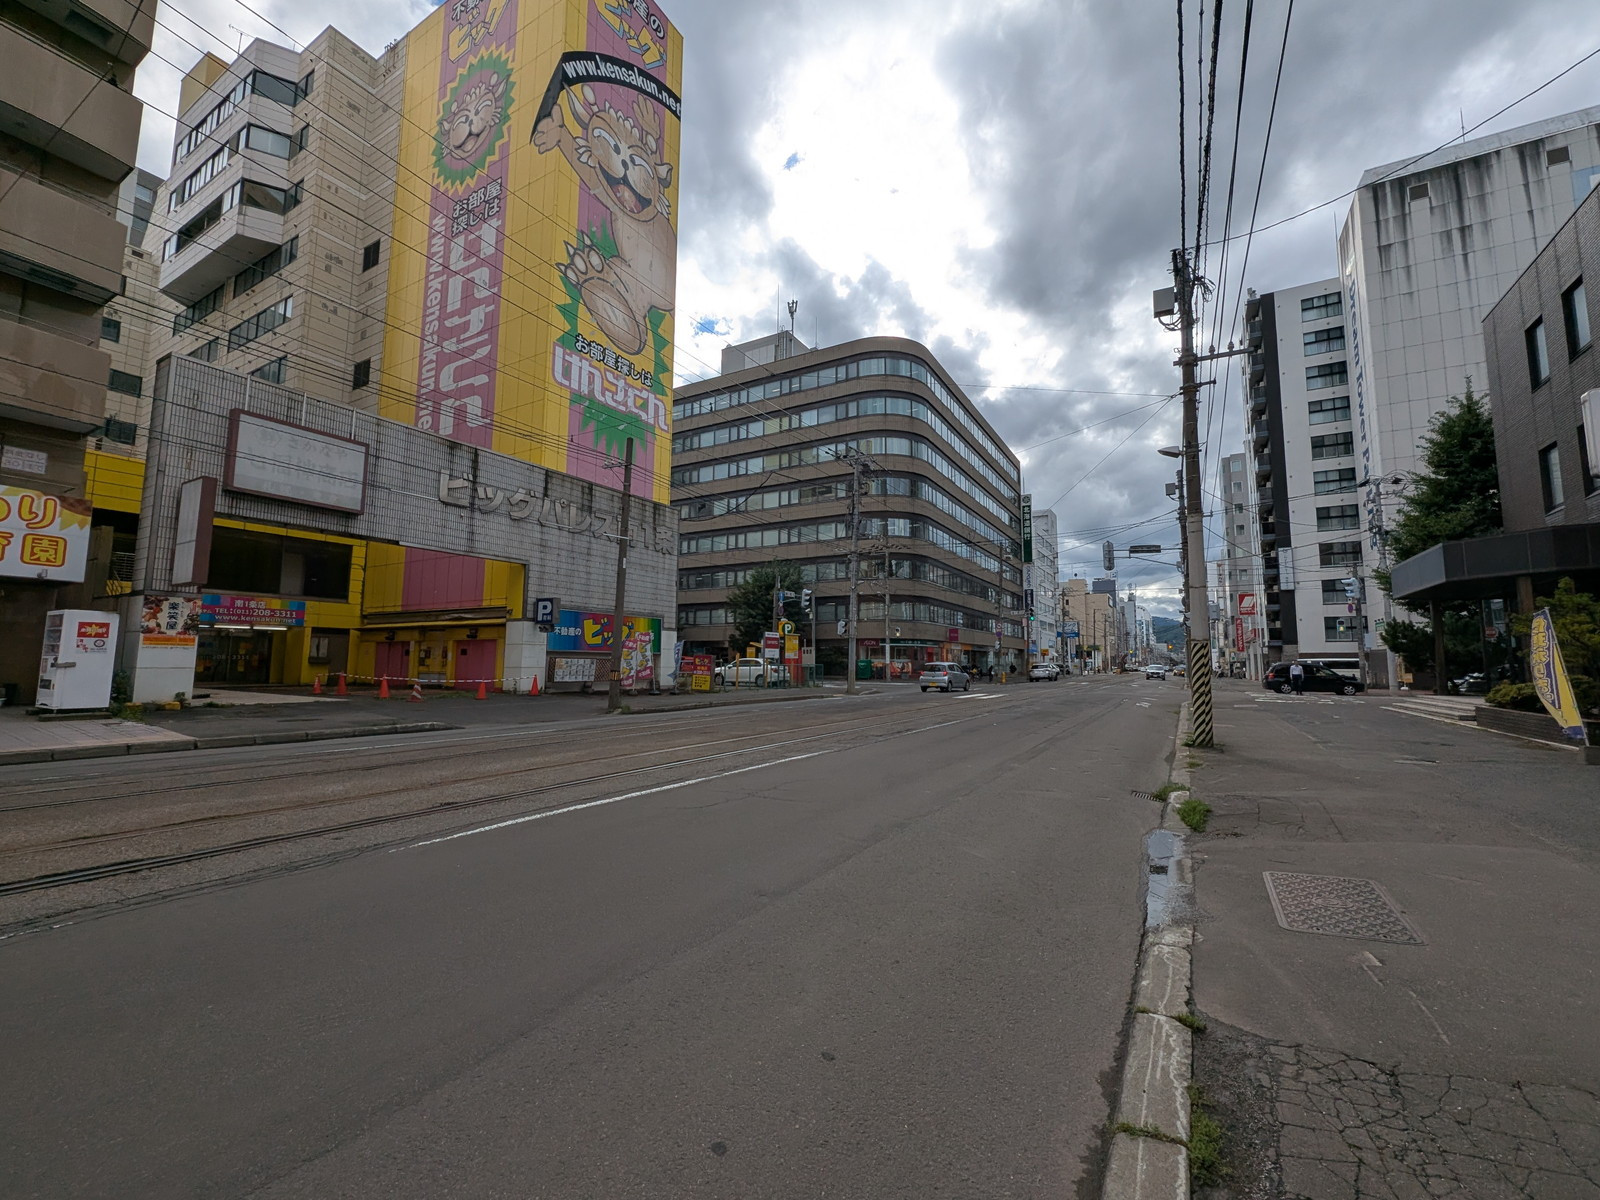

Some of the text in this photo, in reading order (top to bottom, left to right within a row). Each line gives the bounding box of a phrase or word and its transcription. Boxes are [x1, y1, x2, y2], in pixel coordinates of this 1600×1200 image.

[627, 0, 665, 39] 産の
[562, 55, 682, 118] www.kensakun.net
[453, 177, 503, 216] お部屋
[451, 197, 502, 237] 探しは
[417, 216, 446, 432] www.kensakun.ne
[575, 334, 653, 387] お部屋探しは
[1349, 278, 1361, 367] Dream
[1356, 366, 1367, 443] Tower
[553, 345, 670, 431] けんさくん
[537, 601, 552, 621] P
[554, 626, 582, 636] 不動産の
[784, 623, 791, 634] P
